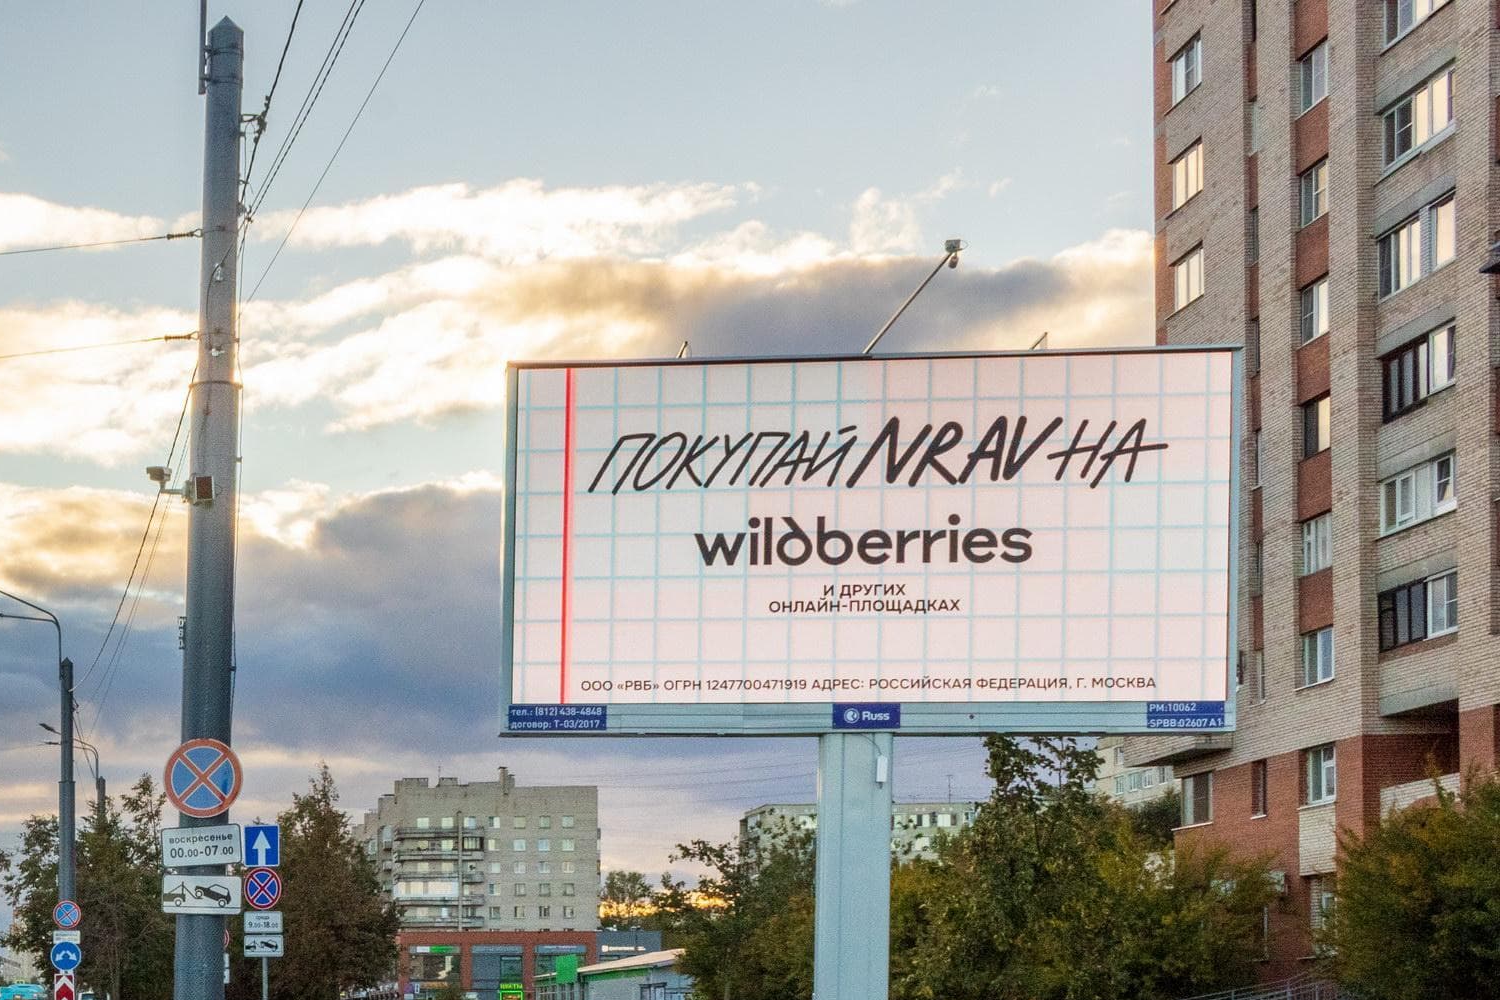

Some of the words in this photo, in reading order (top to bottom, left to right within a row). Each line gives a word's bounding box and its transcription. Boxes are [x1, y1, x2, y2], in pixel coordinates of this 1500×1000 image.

[588, 426, 857, 495] ПОКУПАЙ
[694, 514, 1033, 566] wildberries
[823, 584, 835, 597] И
[839, 583, 906, 598] ДРУГИХ
[769, 597, 960, 615] ОНЛАЙН-ПЛОЩАДКАХ
[581, 680, 613, 691] ООО
[617, 680, 659, 691] «РВБ»
[663, 680, 701, 691] ОГРН
[706, 679, 807, 691] 1247700471919
[811, 678, 864, 692] АДРЕС:
[869, 676, 972, 690] РОССИЙСКАЯ
[976, 677, 1072, 691] ФЕДЕРАЦИЯ,
[1076, 677, 1087, 689] Г.
[1092, 677, 1157, 689] МОСКВА
[535, 706, 558, 717] (812)
[560, 706, 603, 716] 438-4848
[861, 710, 891, 721] Russ
[510, 720, 552, 730] договор:
[169, 833, 234, 845] воскресенье
